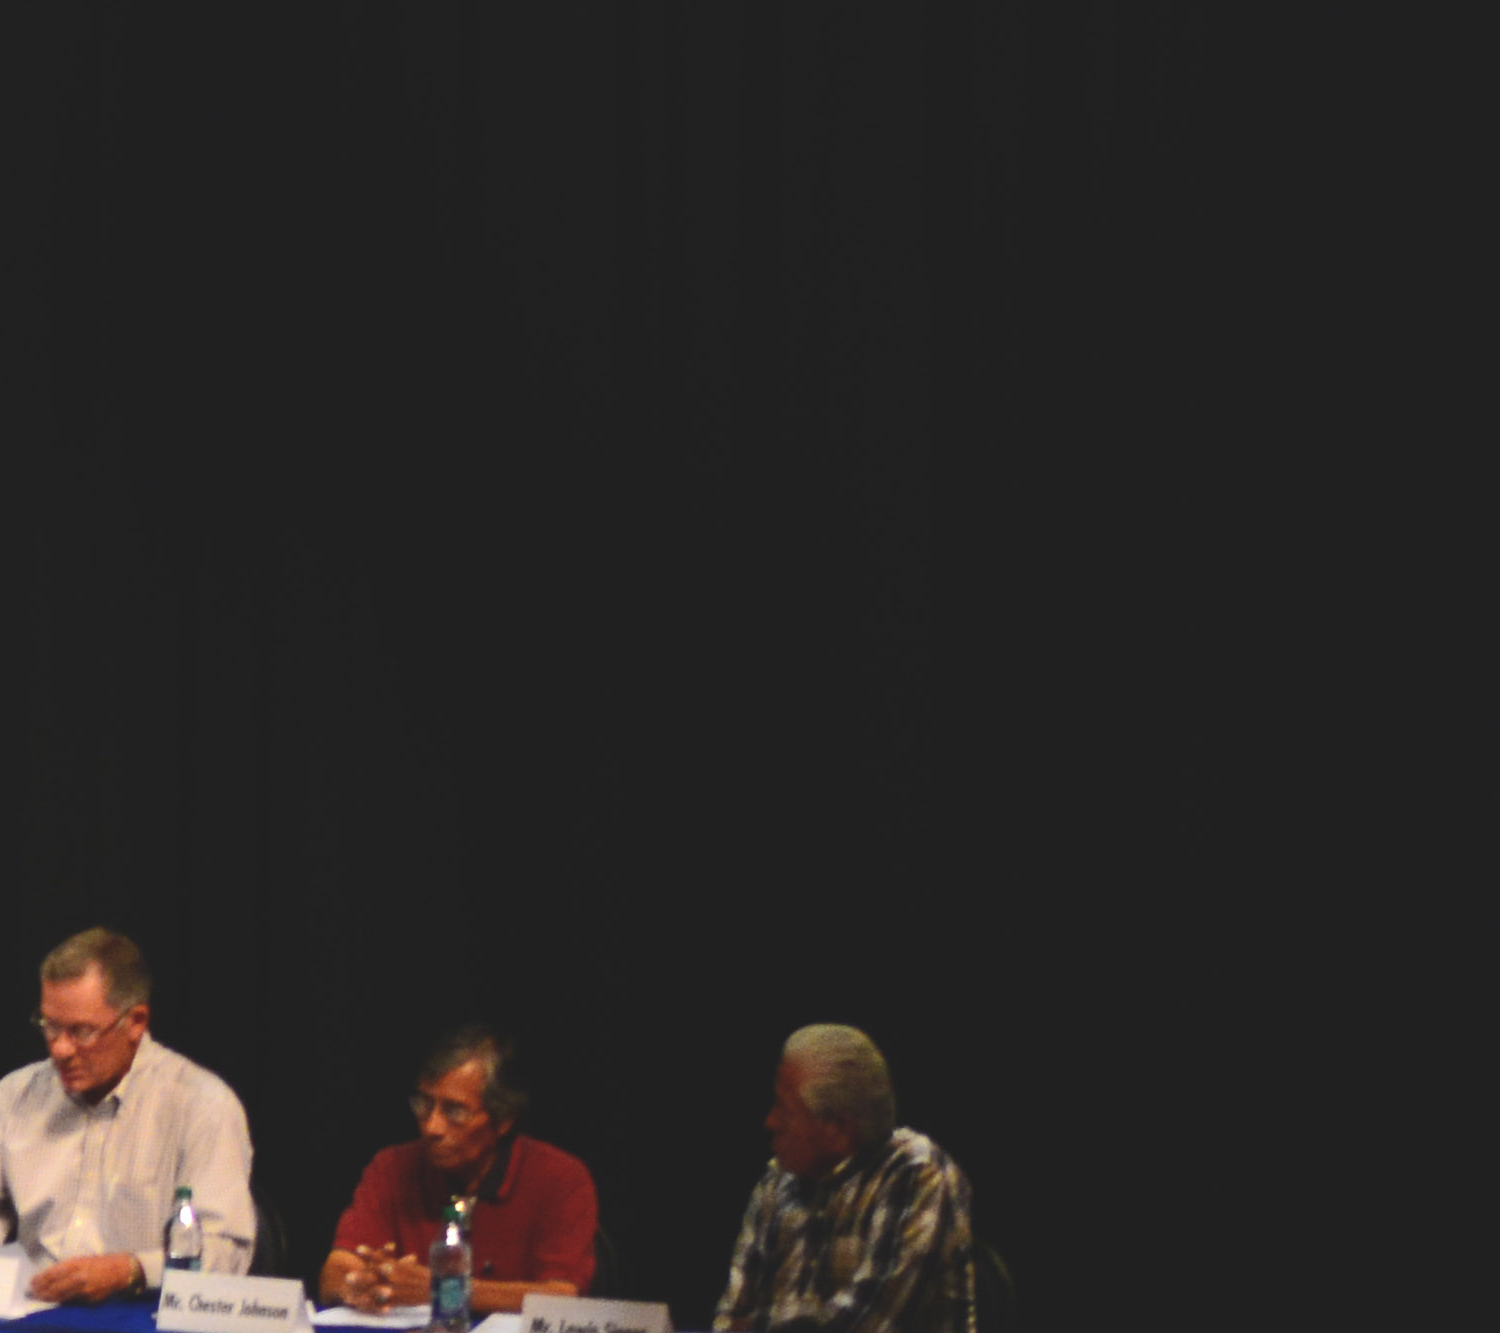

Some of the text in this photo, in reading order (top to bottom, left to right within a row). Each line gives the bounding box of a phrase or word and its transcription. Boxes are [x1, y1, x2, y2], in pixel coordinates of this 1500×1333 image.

[163, 1293, 289, 1320] Mr. Chester Johnson
